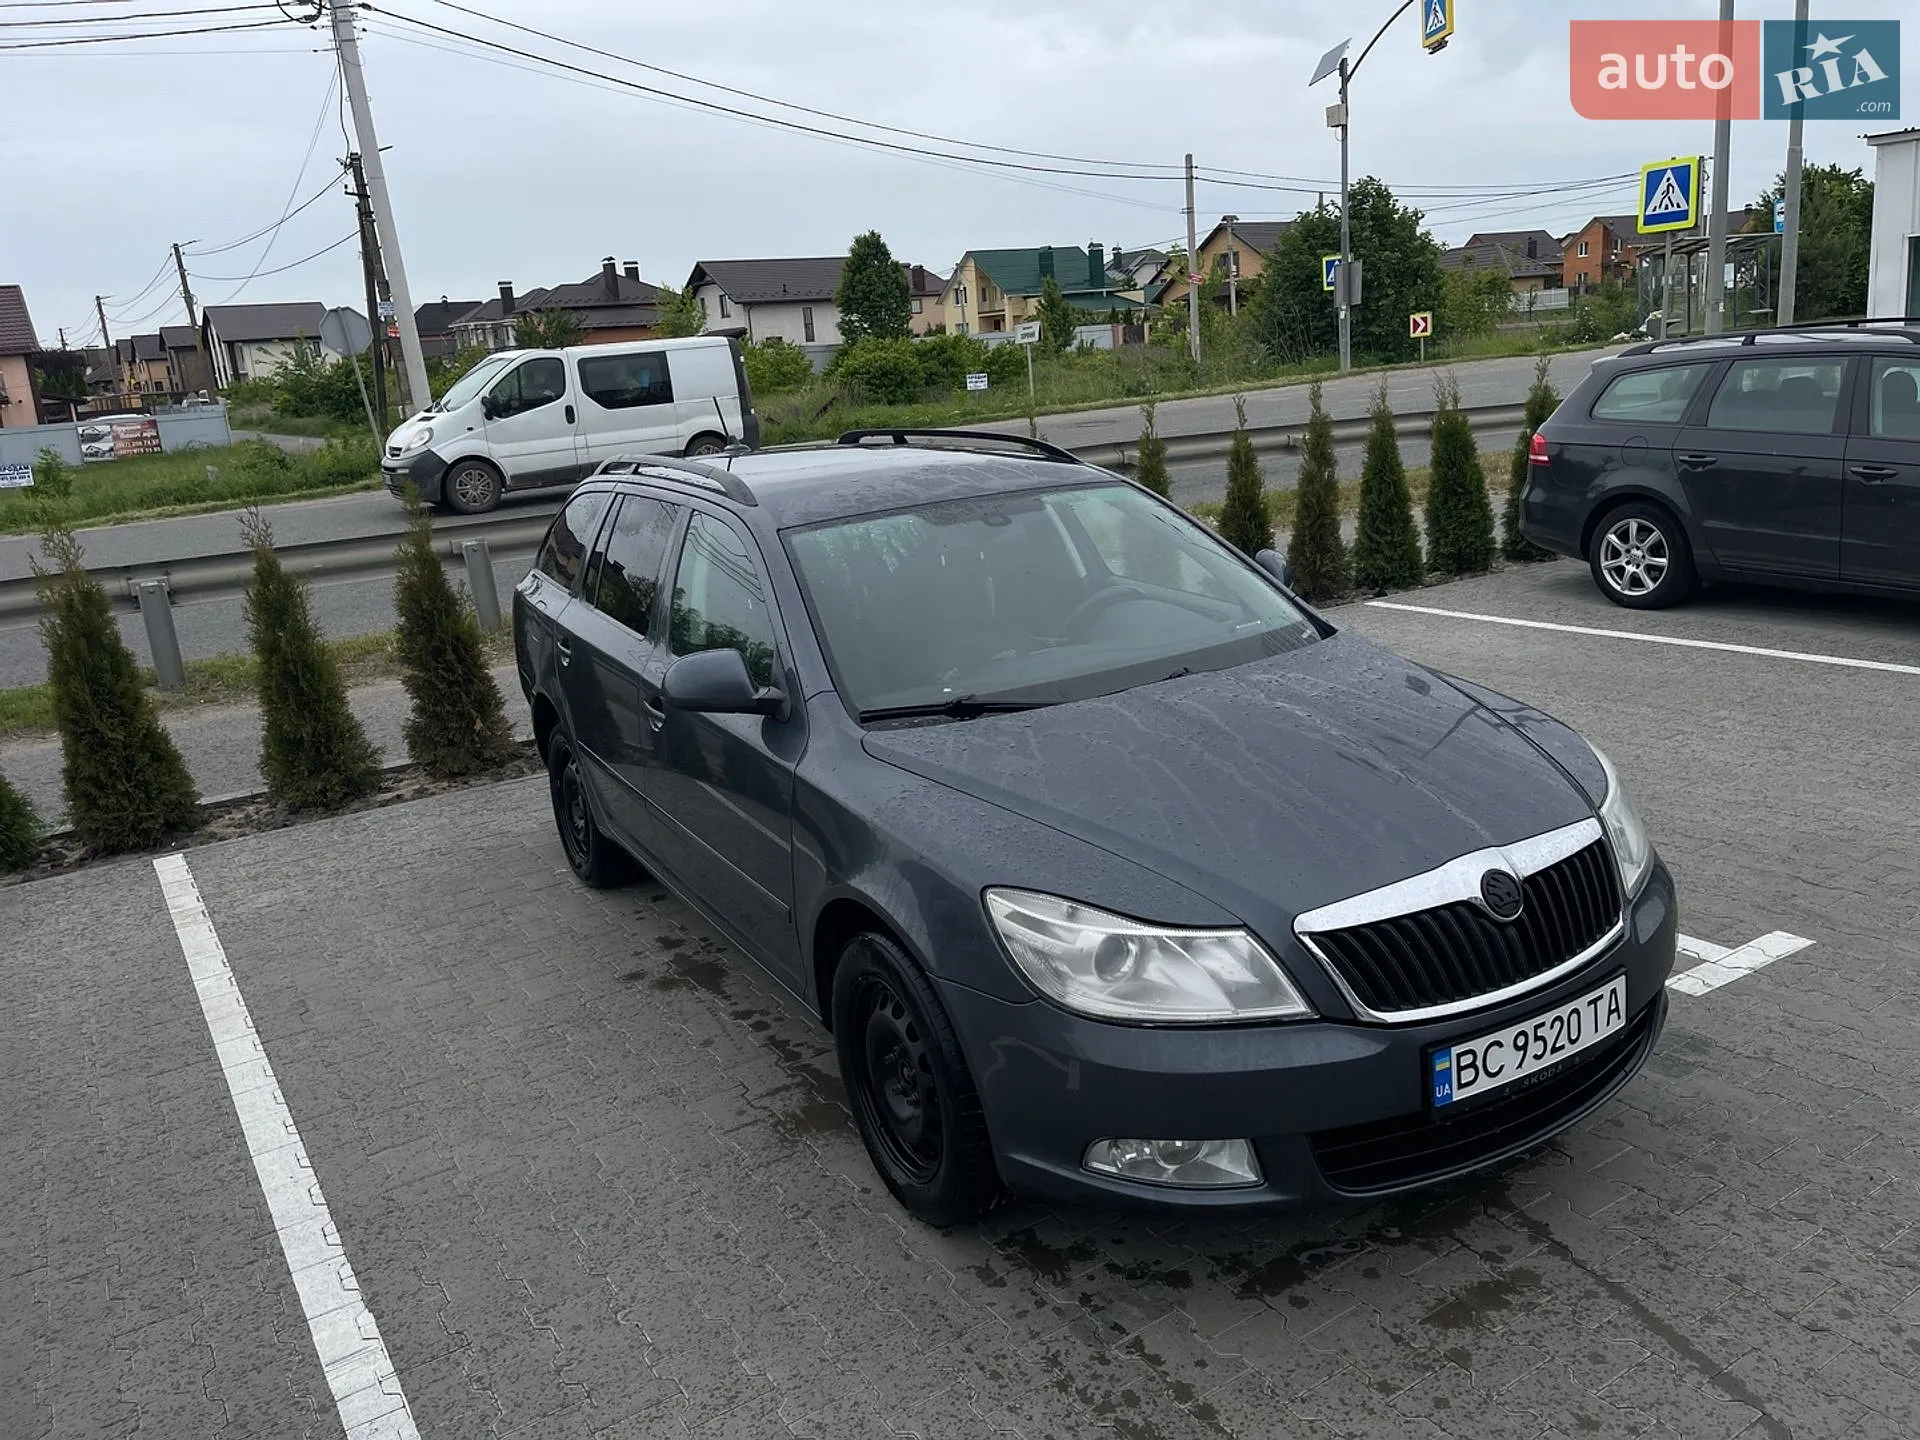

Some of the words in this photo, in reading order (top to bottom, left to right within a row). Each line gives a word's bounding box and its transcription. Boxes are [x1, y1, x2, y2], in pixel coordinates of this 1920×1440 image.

[1456, 1040, 1505, 1090] BC
[1513, 1007, 1581, 1070] 9520
[1587, 987, 1622, 1034] TA
[1435, 1083, 1451, 1098] UA
